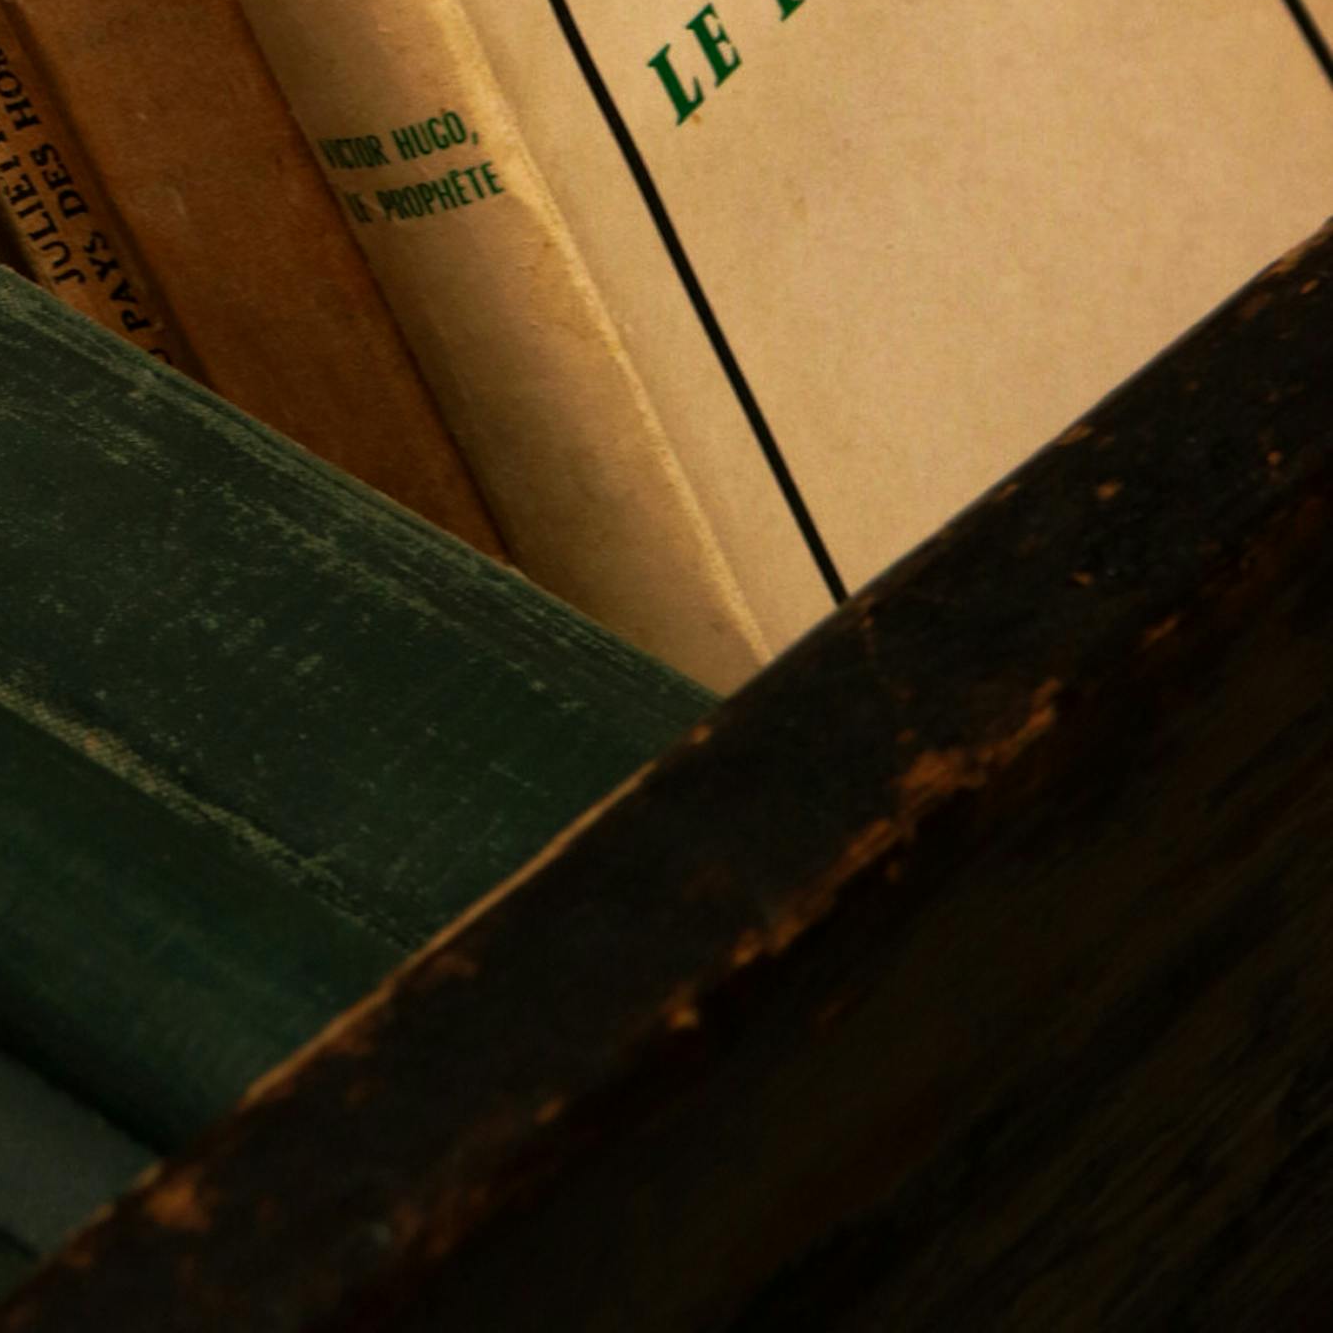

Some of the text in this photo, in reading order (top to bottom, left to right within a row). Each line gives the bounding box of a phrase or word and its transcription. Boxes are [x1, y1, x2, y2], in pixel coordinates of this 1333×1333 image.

[647, 3, 743, 127] LE
[30, 142, 89, 219] DES
[392, 111, 479, 161] HUGO,
[84, 230, 151, 335] PAYS
